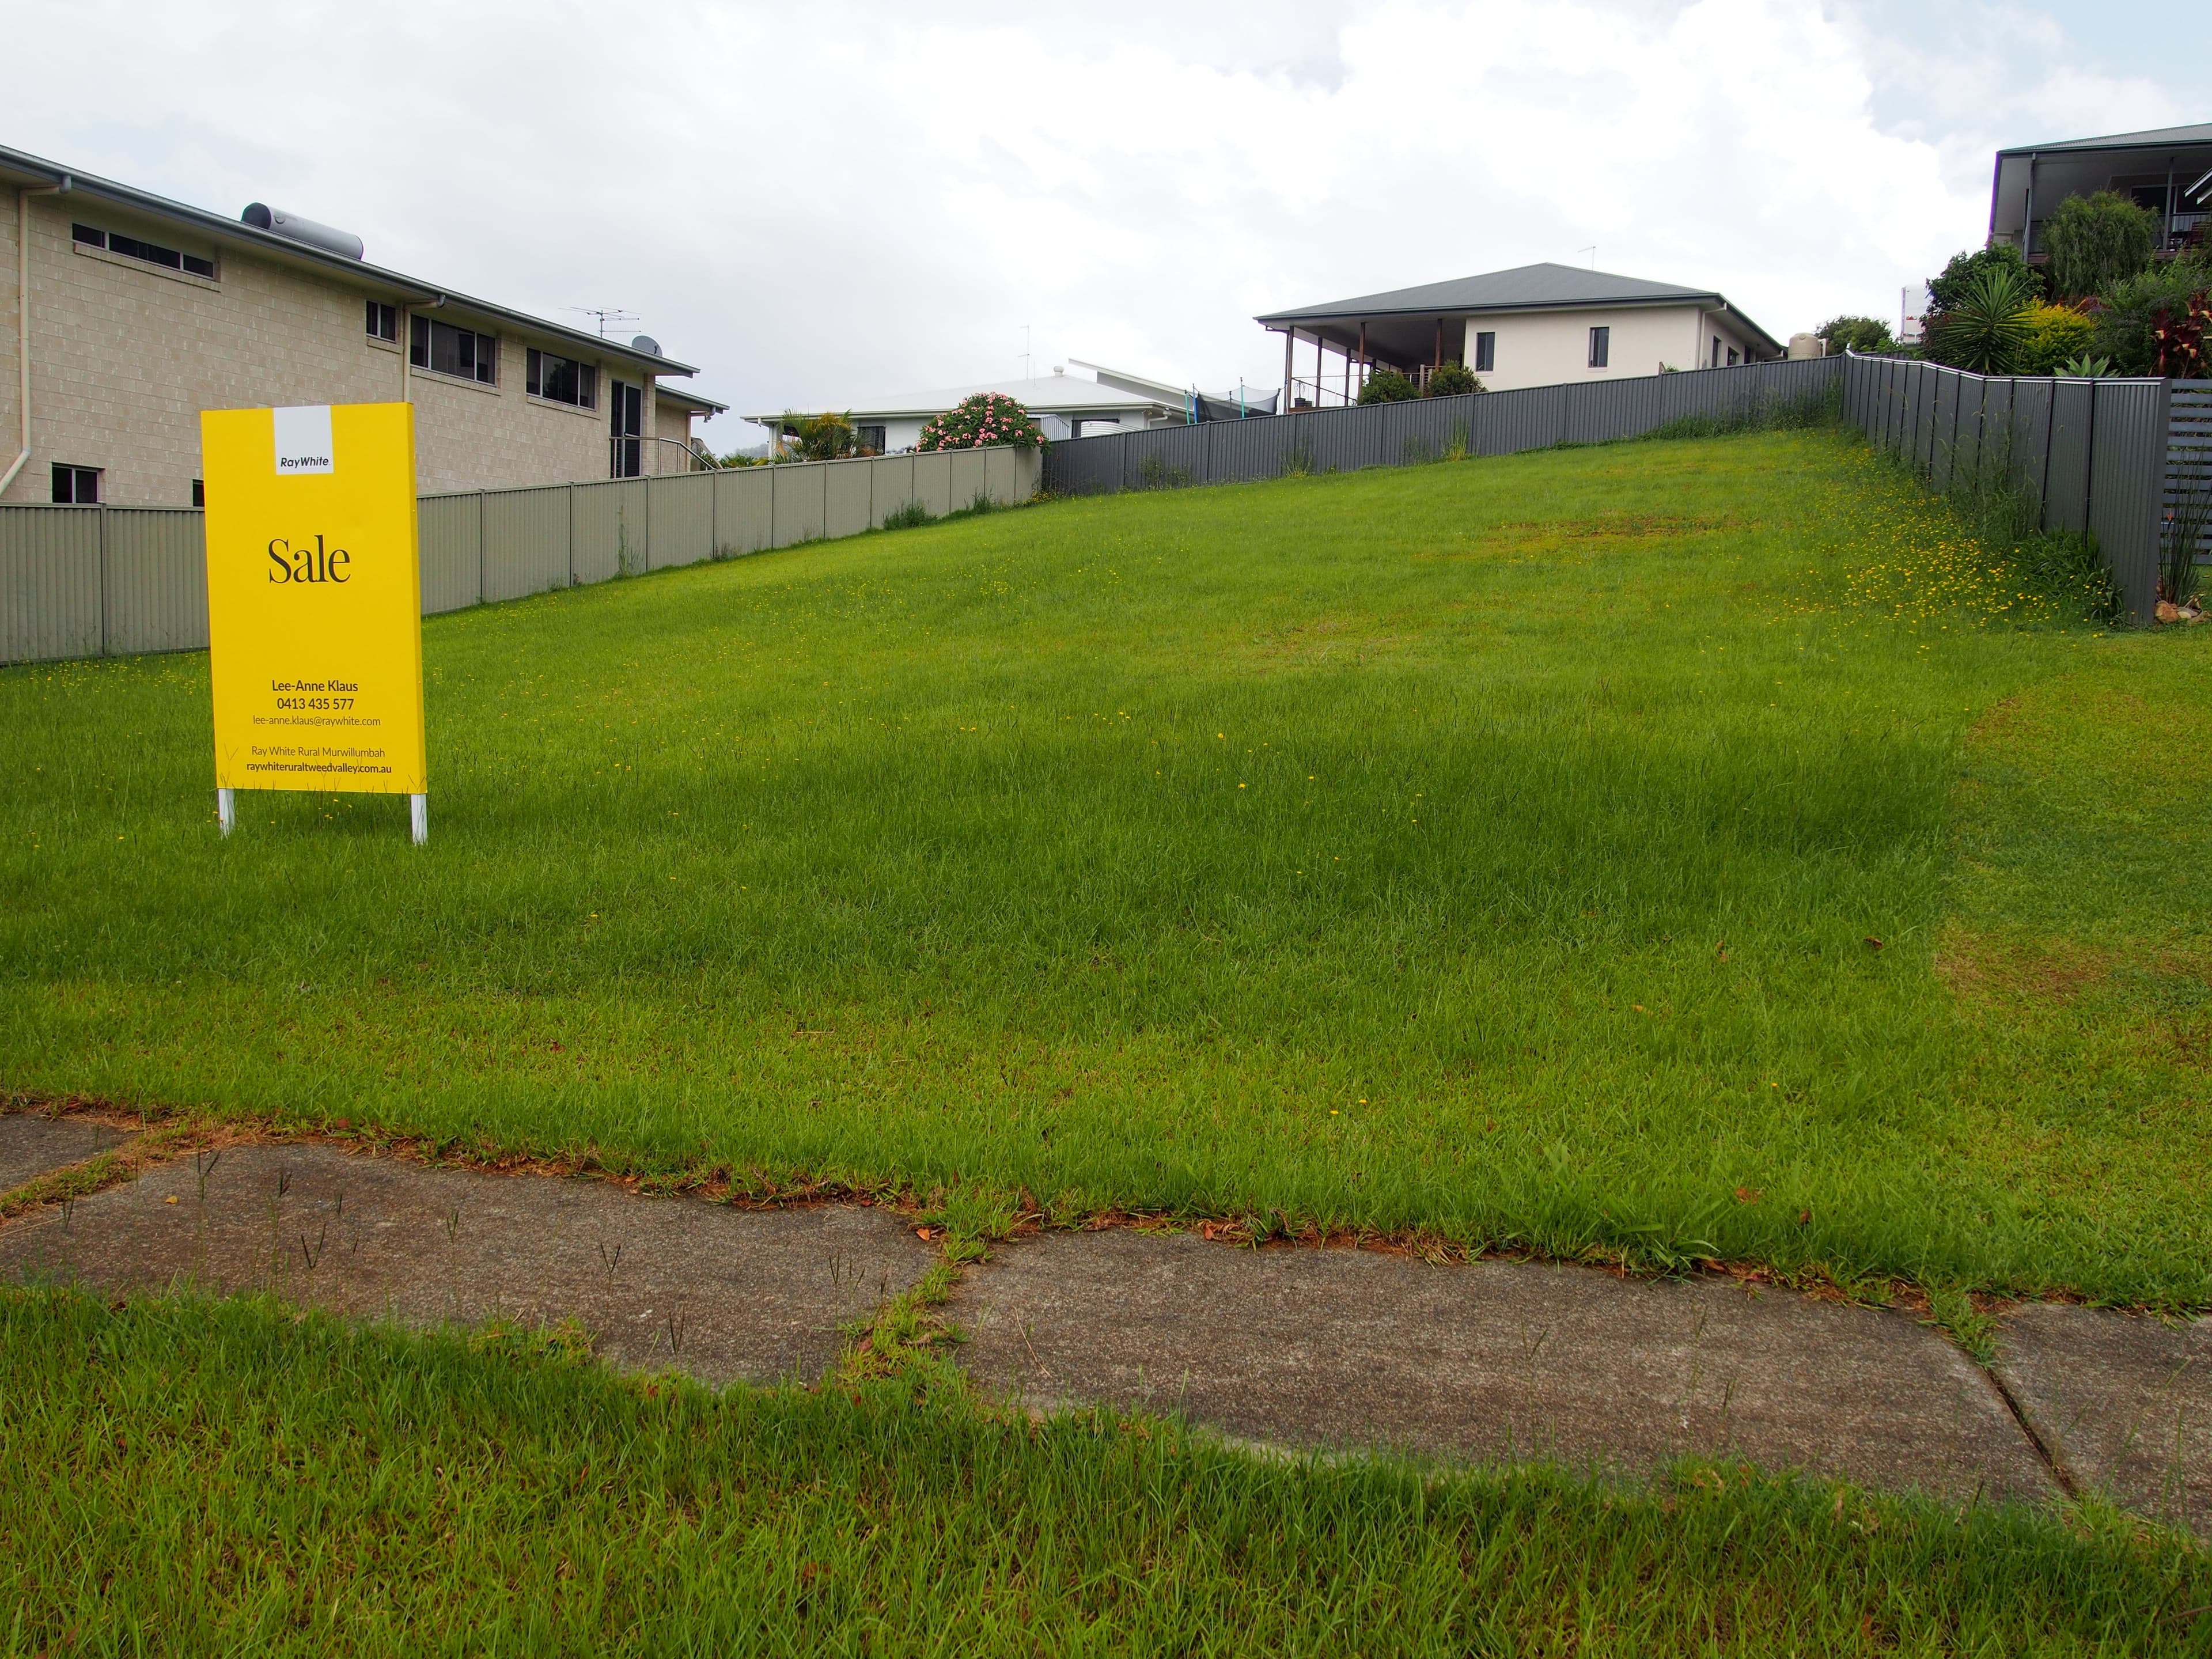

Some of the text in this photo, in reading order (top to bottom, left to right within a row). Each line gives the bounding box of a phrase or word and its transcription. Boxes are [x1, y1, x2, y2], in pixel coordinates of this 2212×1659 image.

[268, 535, 351, 584] Sale
[272, 680, 358, 691] Lee-Anne Klaus
[277, 698, 354, 710] 0413 435 577
[253, 715, 381, 727] lee-anne.klaus@raywhite.com
[252, 746, 385, 757] Ray White Rural Murwillumbah
[247, 762, 392, 774] raywhiteruraltweedvalley.com.au
